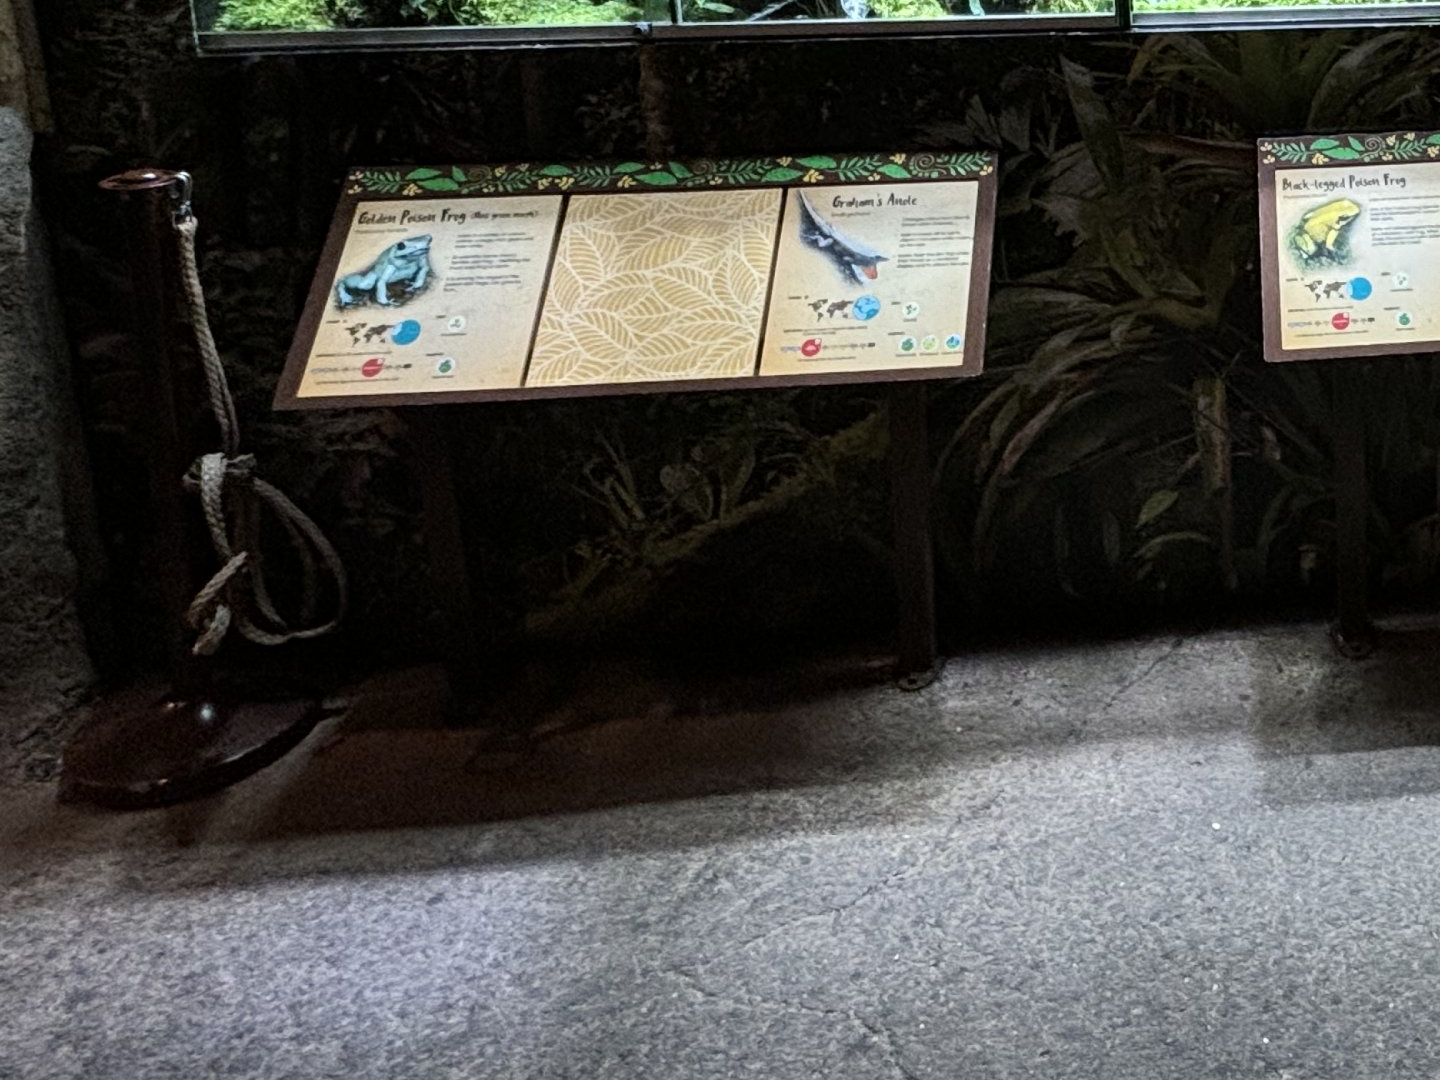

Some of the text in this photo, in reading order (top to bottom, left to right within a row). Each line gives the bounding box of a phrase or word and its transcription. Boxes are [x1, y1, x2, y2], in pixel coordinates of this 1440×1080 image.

[1282, 173, 1406, 192] Black-legged Poison Frog
[832, 192, 918, 208] Graham's Anole
[357, 211, 396, 224] Golden
[400, 209, 436, 225] Poison
[440, 208, 467, 224] Frog
